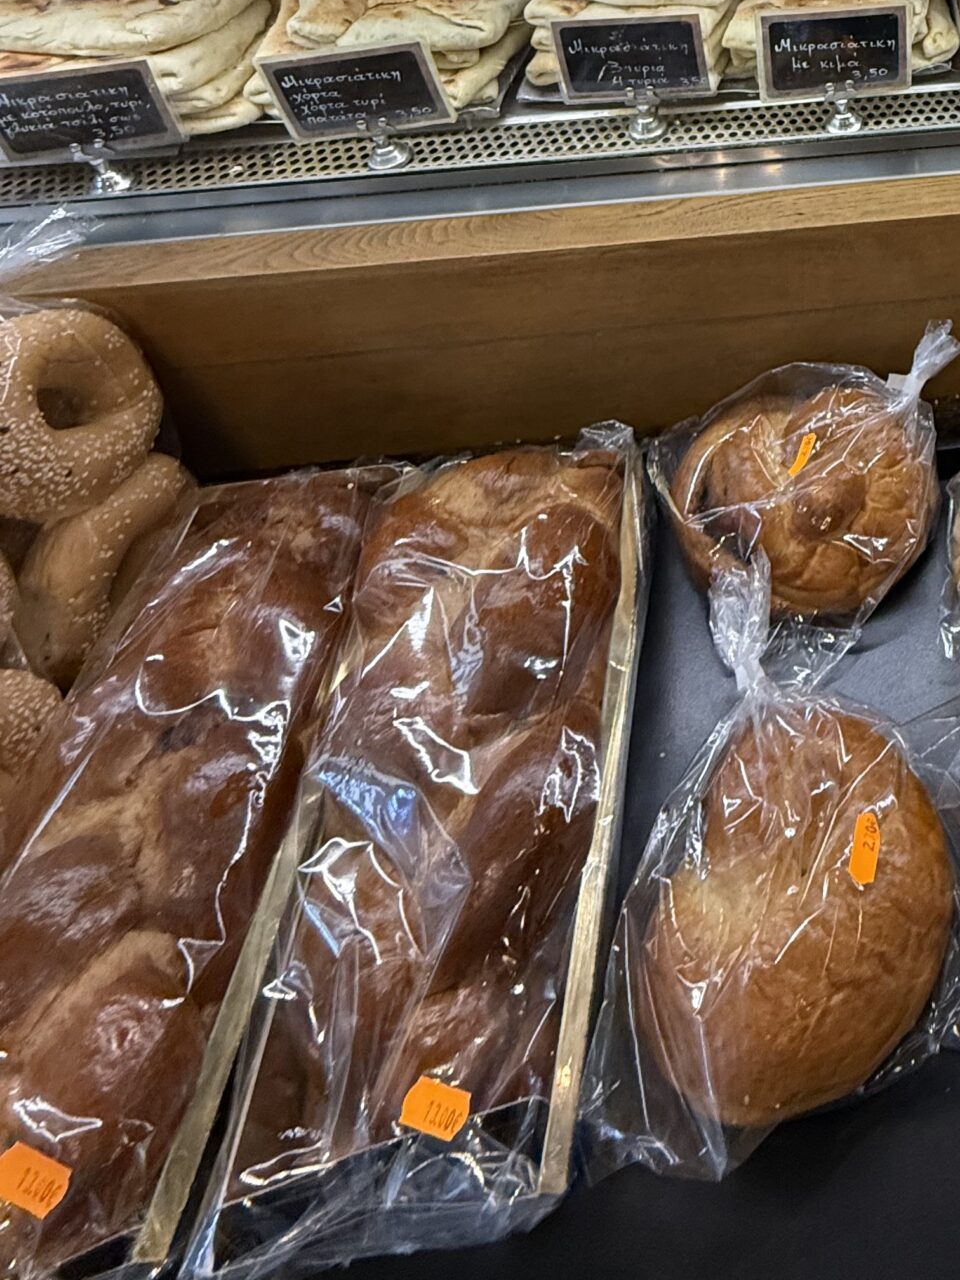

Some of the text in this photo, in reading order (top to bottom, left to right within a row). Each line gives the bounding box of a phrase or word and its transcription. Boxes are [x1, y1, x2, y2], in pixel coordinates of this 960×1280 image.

[775, 34, 896, 57] Μικρασιάτικη
[791, 51, 861, 72] με κιμά
[280, 67, 401, 91] Μικρασιάτικη
[851, 67, 889, 81] 3,50
[352, 92, 386, 111] τυρί
